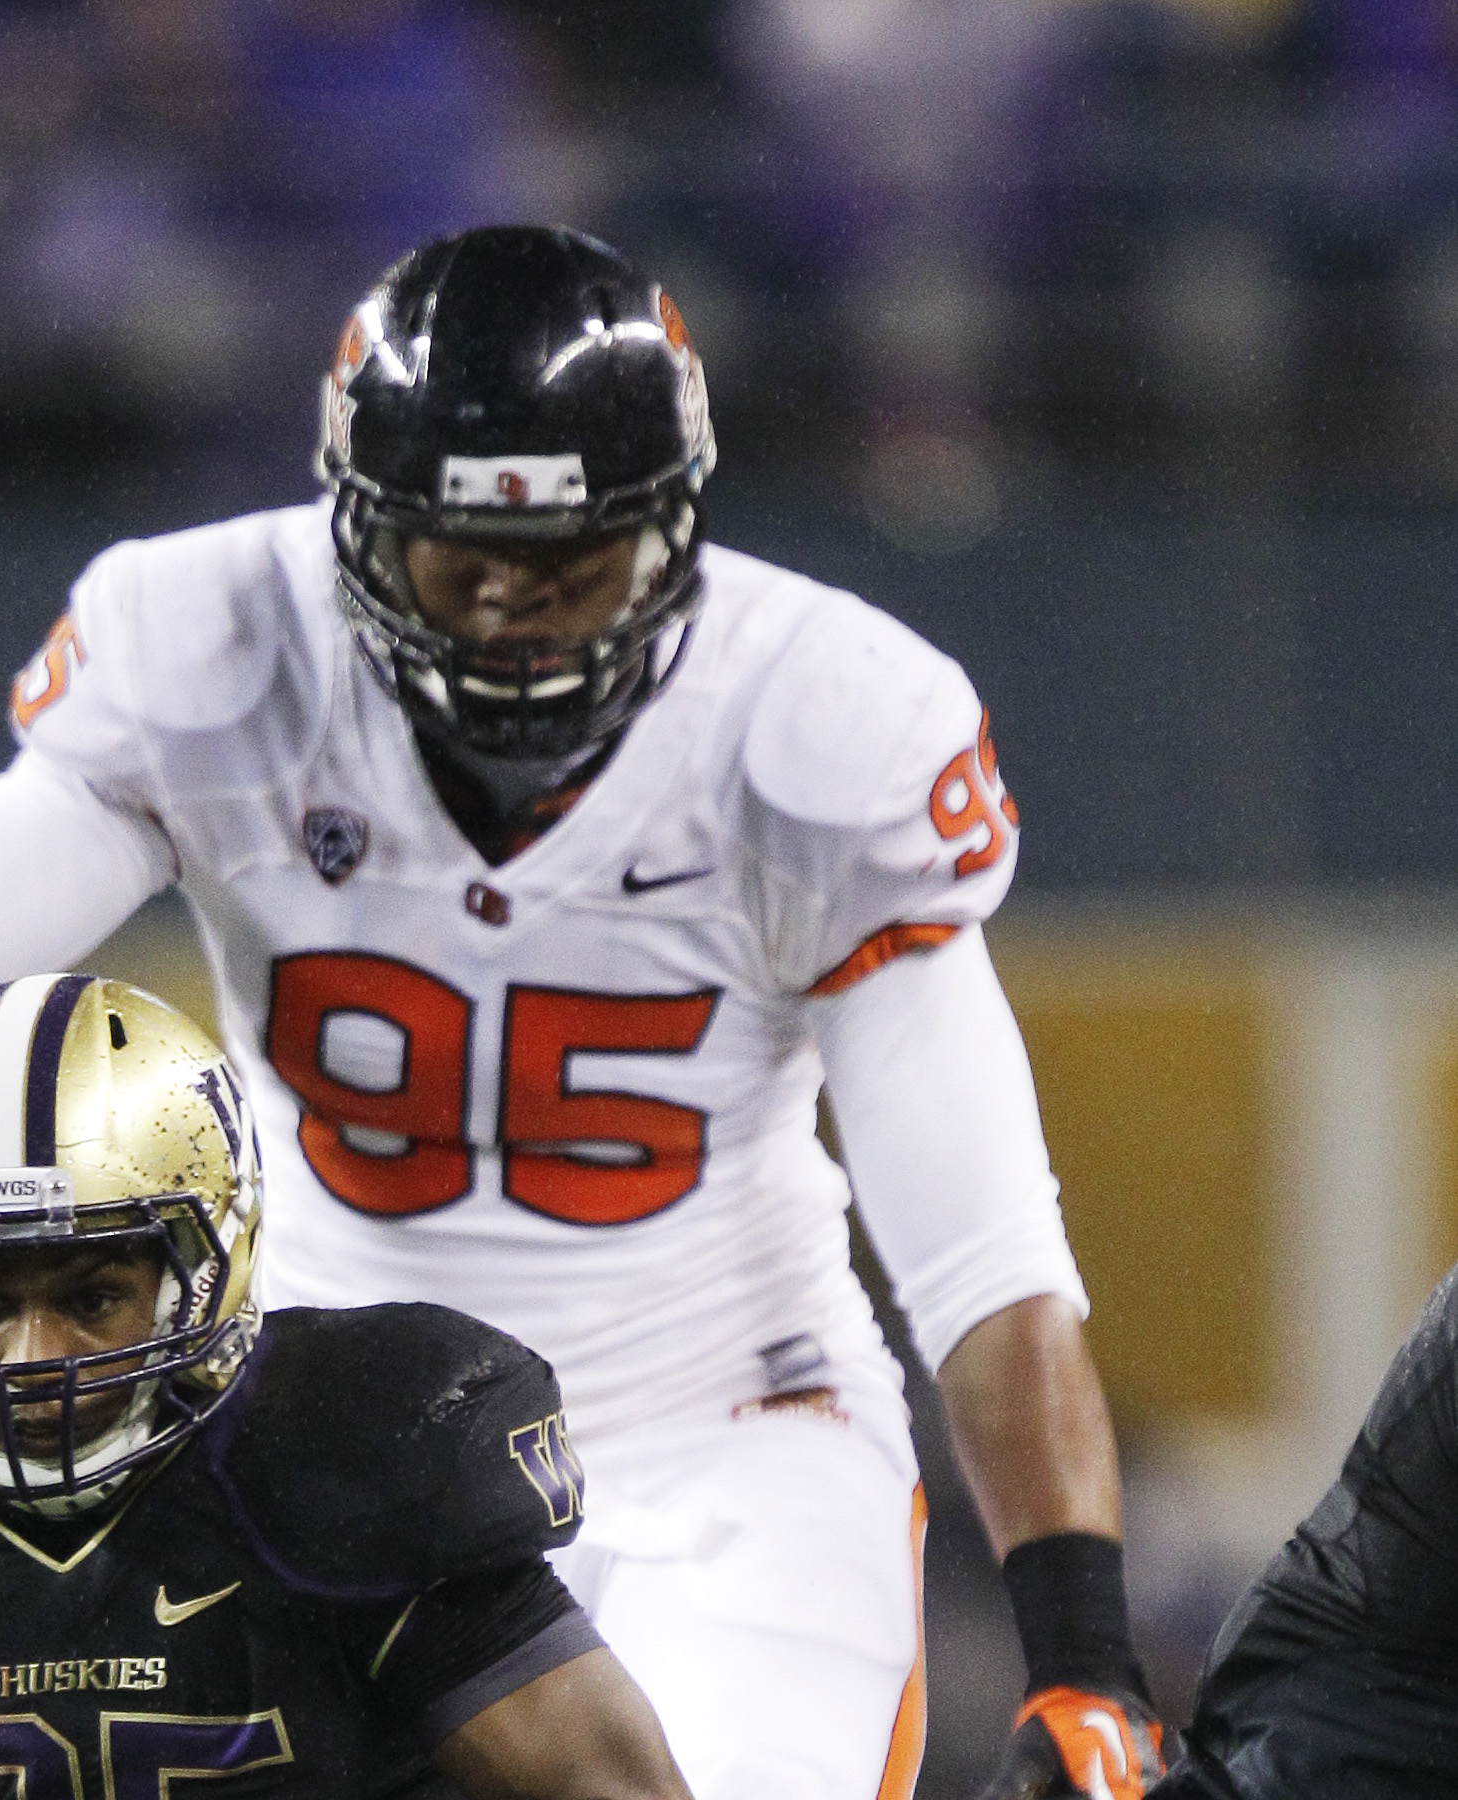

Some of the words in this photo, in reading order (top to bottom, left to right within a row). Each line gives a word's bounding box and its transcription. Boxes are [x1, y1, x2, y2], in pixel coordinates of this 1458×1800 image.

[266, 949, 725, 1226] 95
[508, 1408, 584, 1527] W
[0, 1657, 168, 1697] HUSKIES
